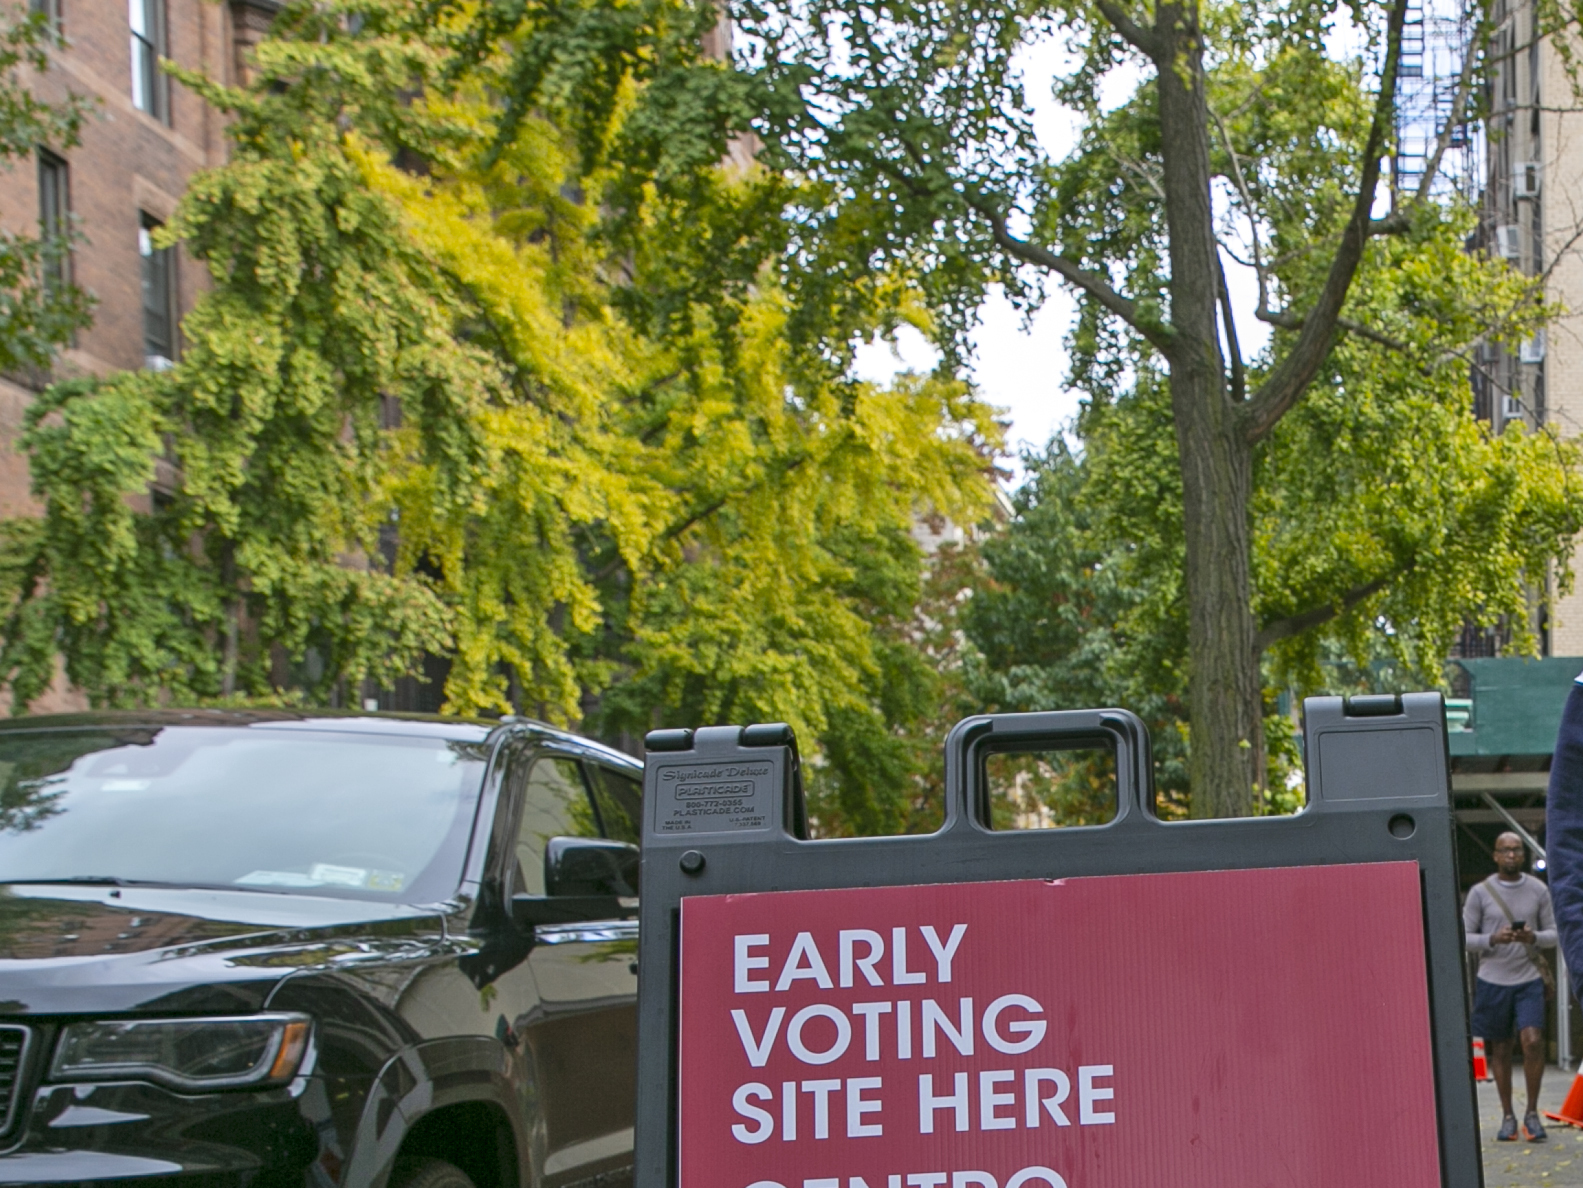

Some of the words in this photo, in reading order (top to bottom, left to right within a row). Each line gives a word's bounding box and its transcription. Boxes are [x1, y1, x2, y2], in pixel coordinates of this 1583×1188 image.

[663, 769, 723, 782] Signicade
[726, 766, 768, 778] Deluxe
[678, 784, 749, 796] PLASTICADE
[674, 806, 754, 816] PLASTICADE.COM
[733, 923, 968, 993] EARLY
[731, 993, 1048, 1068] VOTING
[731, 1075, 884, 1144] SITE
[919, 1064, 1116, 1134] HERE
